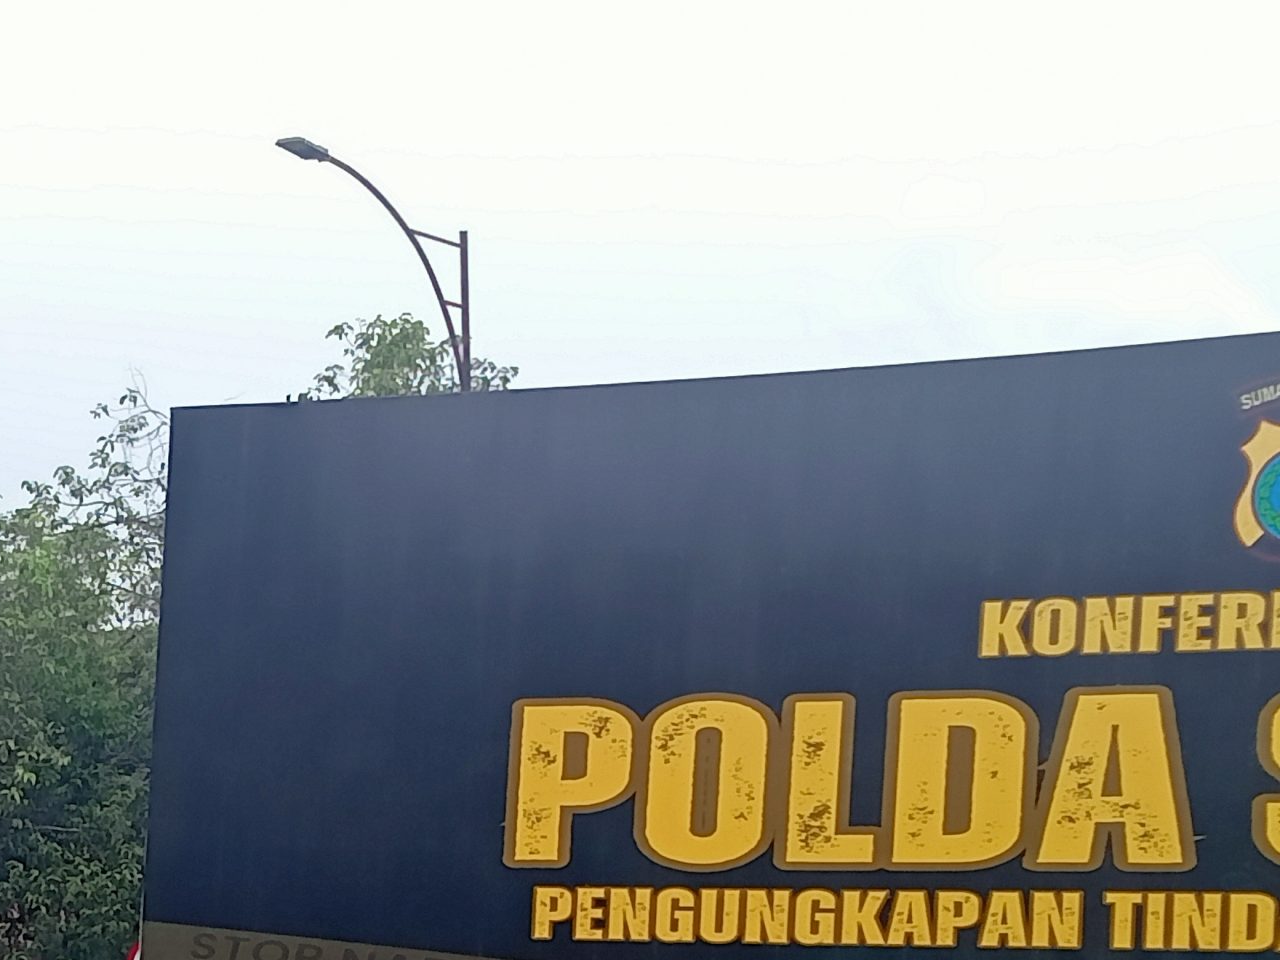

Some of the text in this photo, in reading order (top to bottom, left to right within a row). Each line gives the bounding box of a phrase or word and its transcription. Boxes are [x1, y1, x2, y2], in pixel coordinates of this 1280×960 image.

[504, 684, 1197, 872] POLDA
[531, 886, 1280, 951] PENGUNGKAPAN TIND
